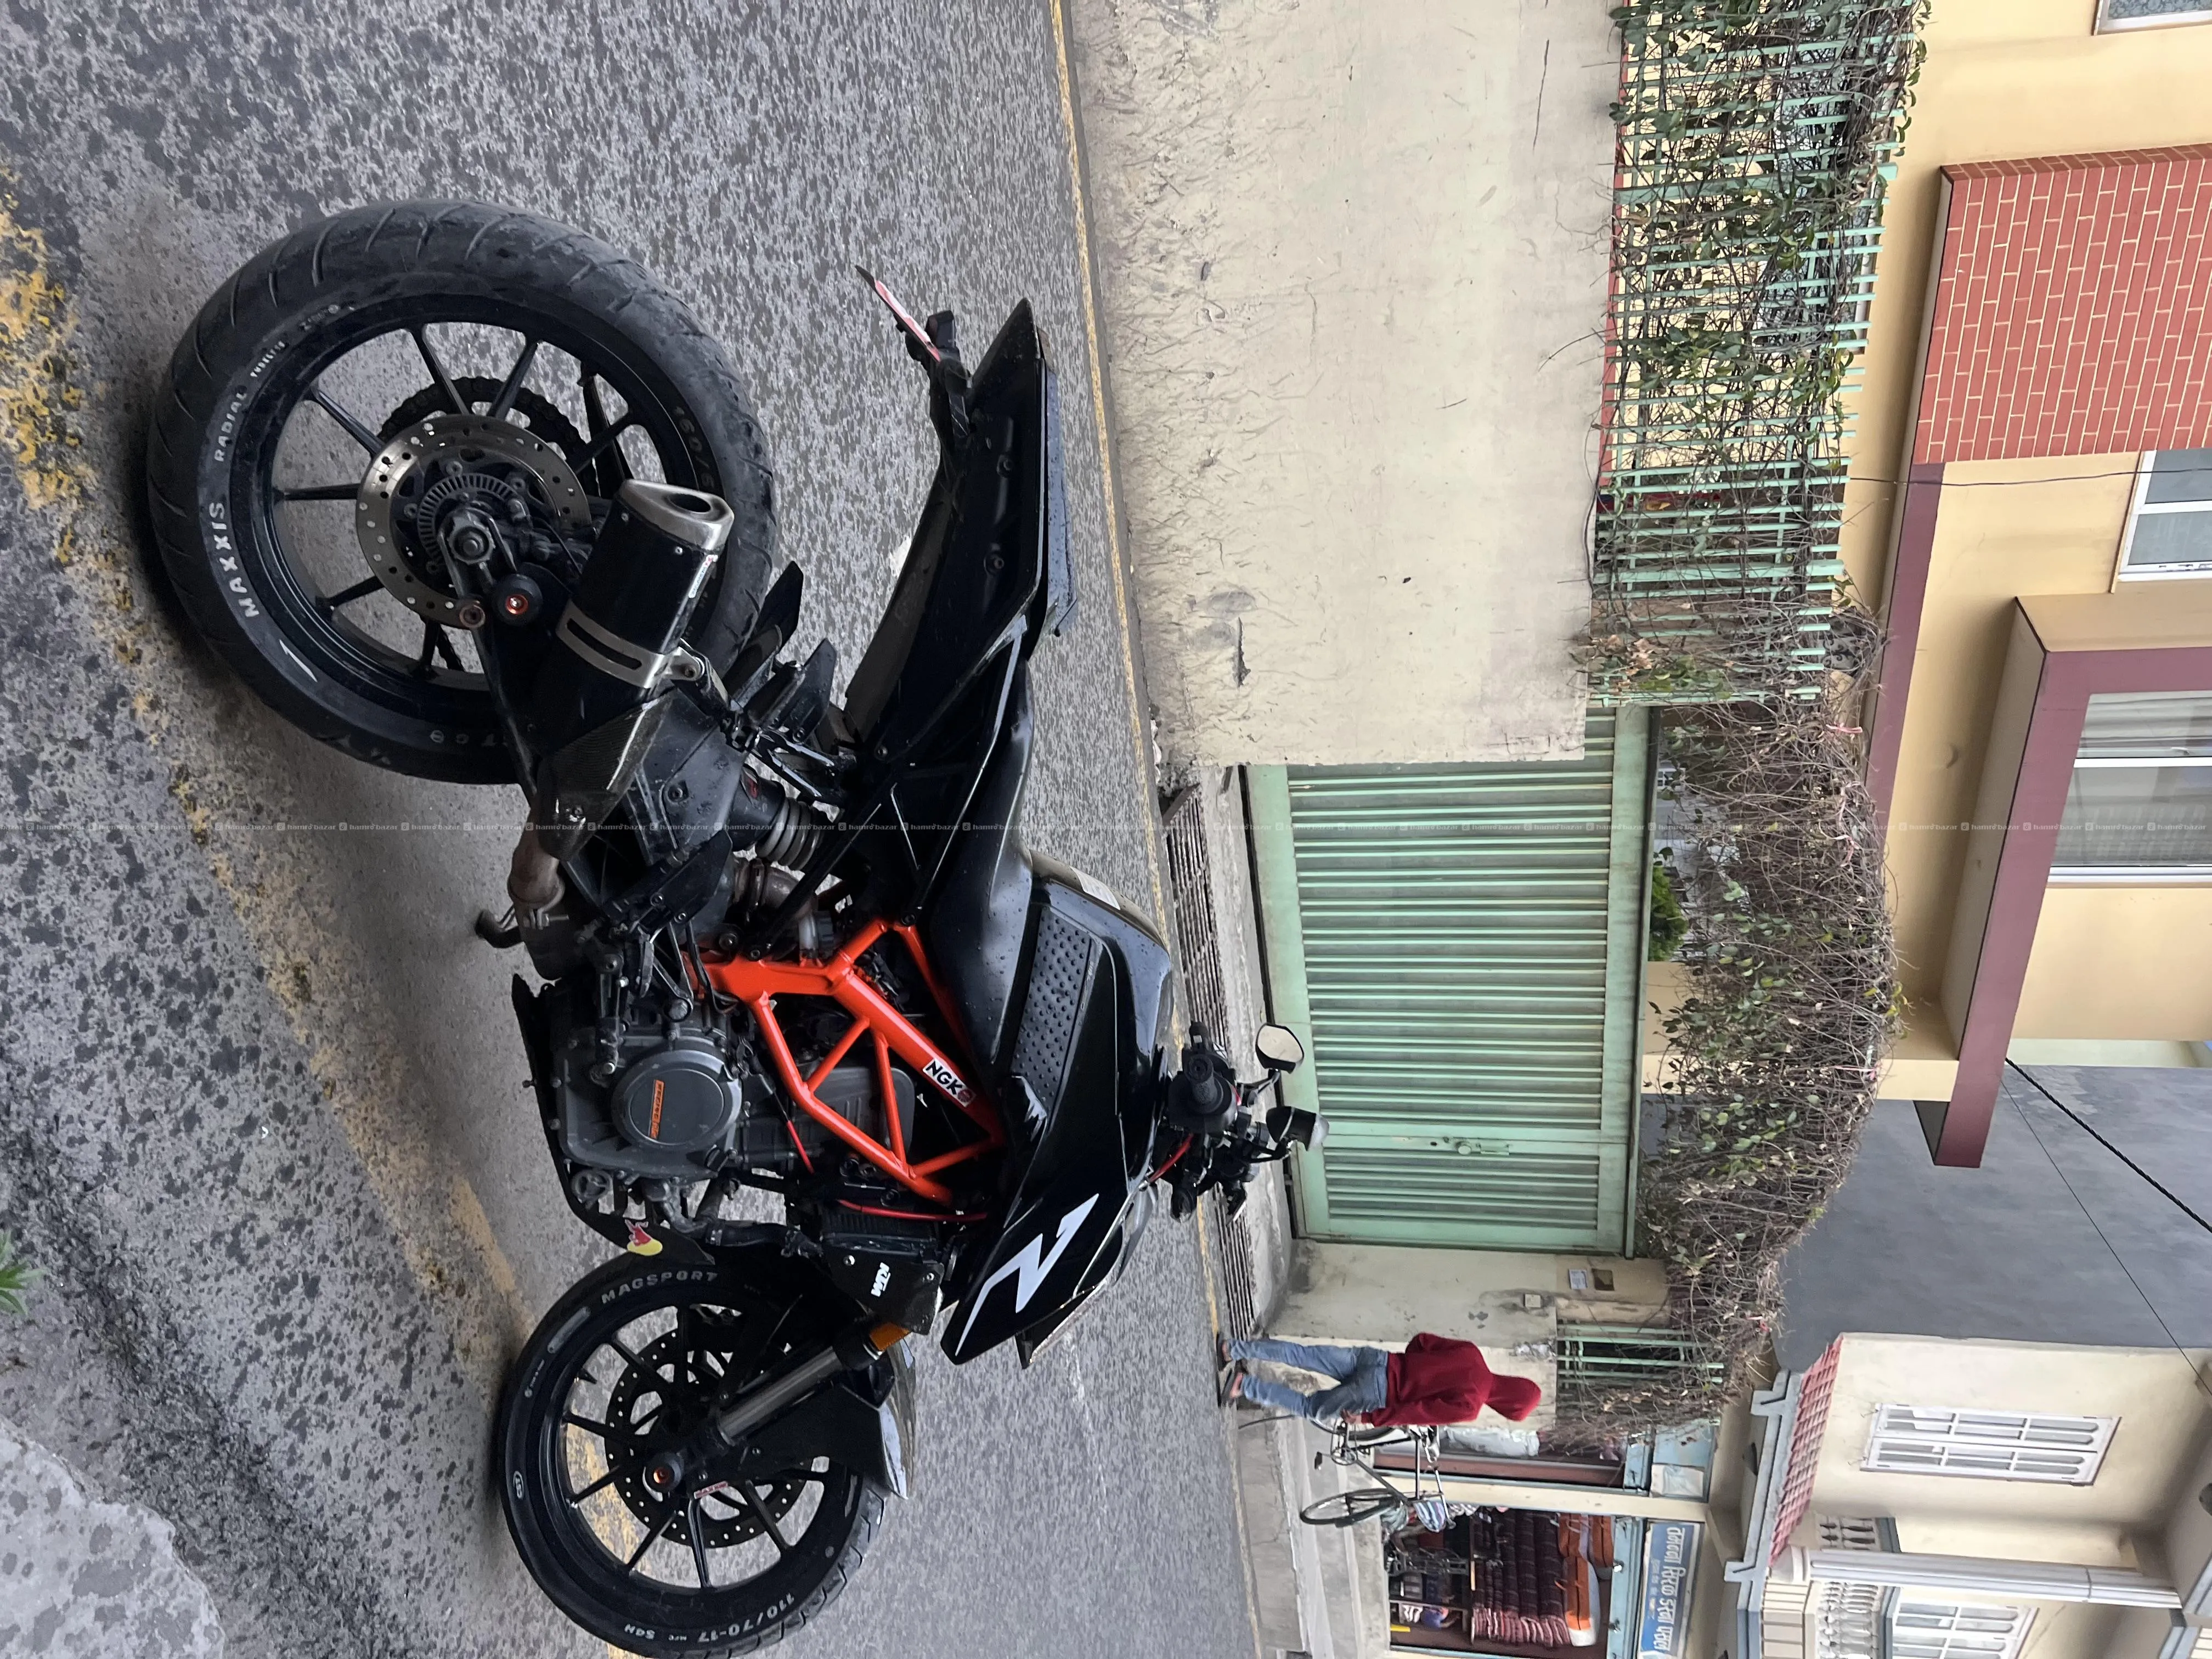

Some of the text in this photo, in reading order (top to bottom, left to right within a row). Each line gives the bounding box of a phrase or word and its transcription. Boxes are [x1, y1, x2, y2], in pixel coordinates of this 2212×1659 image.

[213, 392, 250, 462] RADIAL
[208, 502, 261, 618] MAXXIS
[924, 1059, 963, 1096] NGK
[600, 1269, 718, 1304] MAGSPORT
[870, 1262, 891, 1297] KTM
[697, 1593, 795, 1641] 110/70-17
